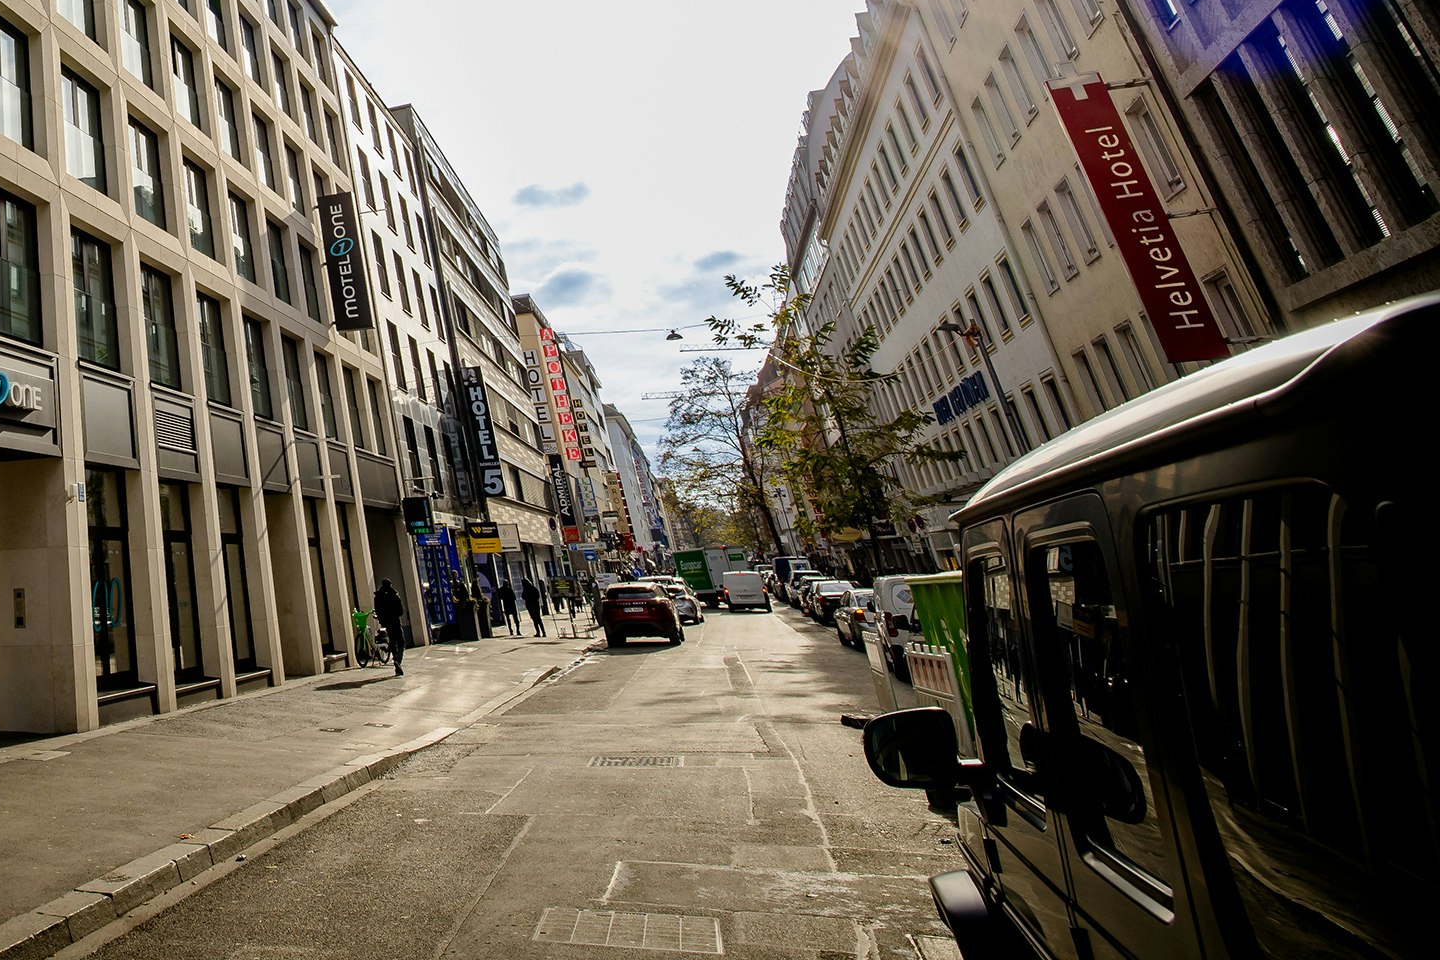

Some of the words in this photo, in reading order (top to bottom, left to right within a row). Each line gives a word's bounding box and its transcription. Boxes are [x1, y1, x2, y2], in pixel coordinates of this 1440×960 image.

[1084, 125, 1144, 199] Hotel
[329, 203, 346, 239] ONE
[338, 254, 359, 319] MOTEL
[1131, 208, 1205, 330] Helvetia
[9, 381, 43, 411] ONE
[468, 386, 495, 460] HOTEL
[523, 350, 552, 440] HOTEL
[541, 328, 581, 461] APOTHEKE
[574, 400, 594, 457] HOTEL
[483, 468, 504, 495] 5
[552, 463, 571, 517] ADMIRAL
